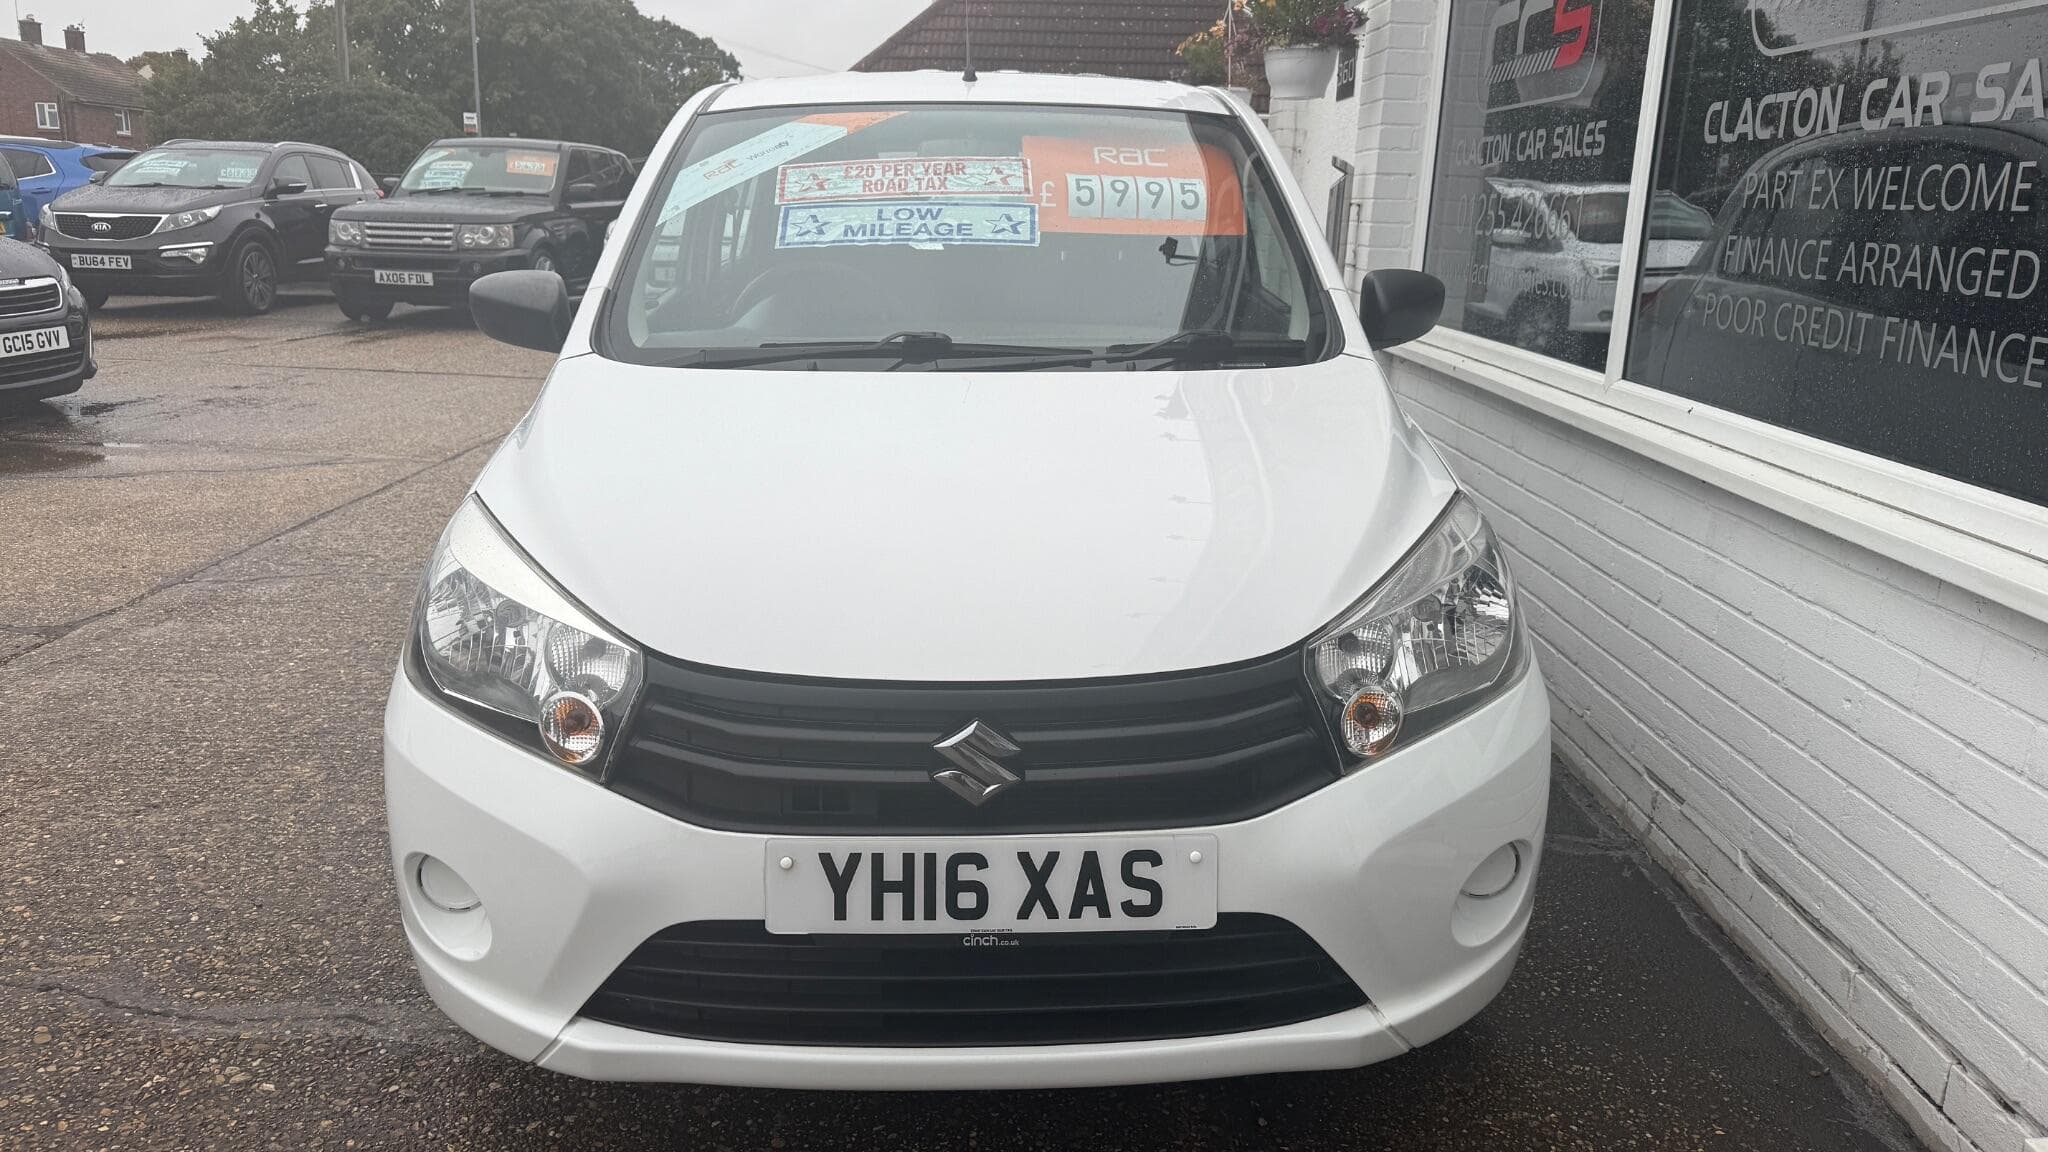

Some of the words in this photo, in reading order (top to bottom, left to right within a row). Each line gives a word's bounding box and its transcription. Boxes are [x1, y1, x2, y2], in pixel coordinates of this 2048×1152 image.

[1704, 84, 1845, 144] CLACTON
[1860, 71, 1950, 130] CAR
[1456, 133, 1511, 166] CLACTON
[1517, 128, 1545, 162] CAR
[1551, 120, 1607, 159] SALES
[843, 164, 875, 180] £20
[881, 162, 913, 177] PER
[922, 161, 967, 177] YEAR
[862, 178, 909, 193] ROAD
[914, 177, 948, 192] TAX
[1743, 169, 1802, 209] PART
[1808, 168, 1846, 210] EX
[1854, 160, 2038, 212] WELCOME
[876, 208, 944, 222] LOW
[842, 223, 974, 238] MILEAGE
[78, 256, 105, 267] BU64
[108, 257, 129, 267] FEV
[1723, 235, 1832, 281] FINANCE
[1836, 242, 2040, 299] ARRANGED
[379, 271, 405, 283] AX06
[408, 273, 429, 285] FDL
[3, 334, 34, 354] GC15
[36, 329, 60, 349] GVV
[1703, 293, 1767, 337] POOR
[1774, 302, 1873, 355] CREDIT
[1880, 316, 2048, 388] FINANCE
[818, 850, 989, 921] YH16
[1016, 849, 1163, 919] XAS
[963, 933, 1020, 946] cinch.co.uk
